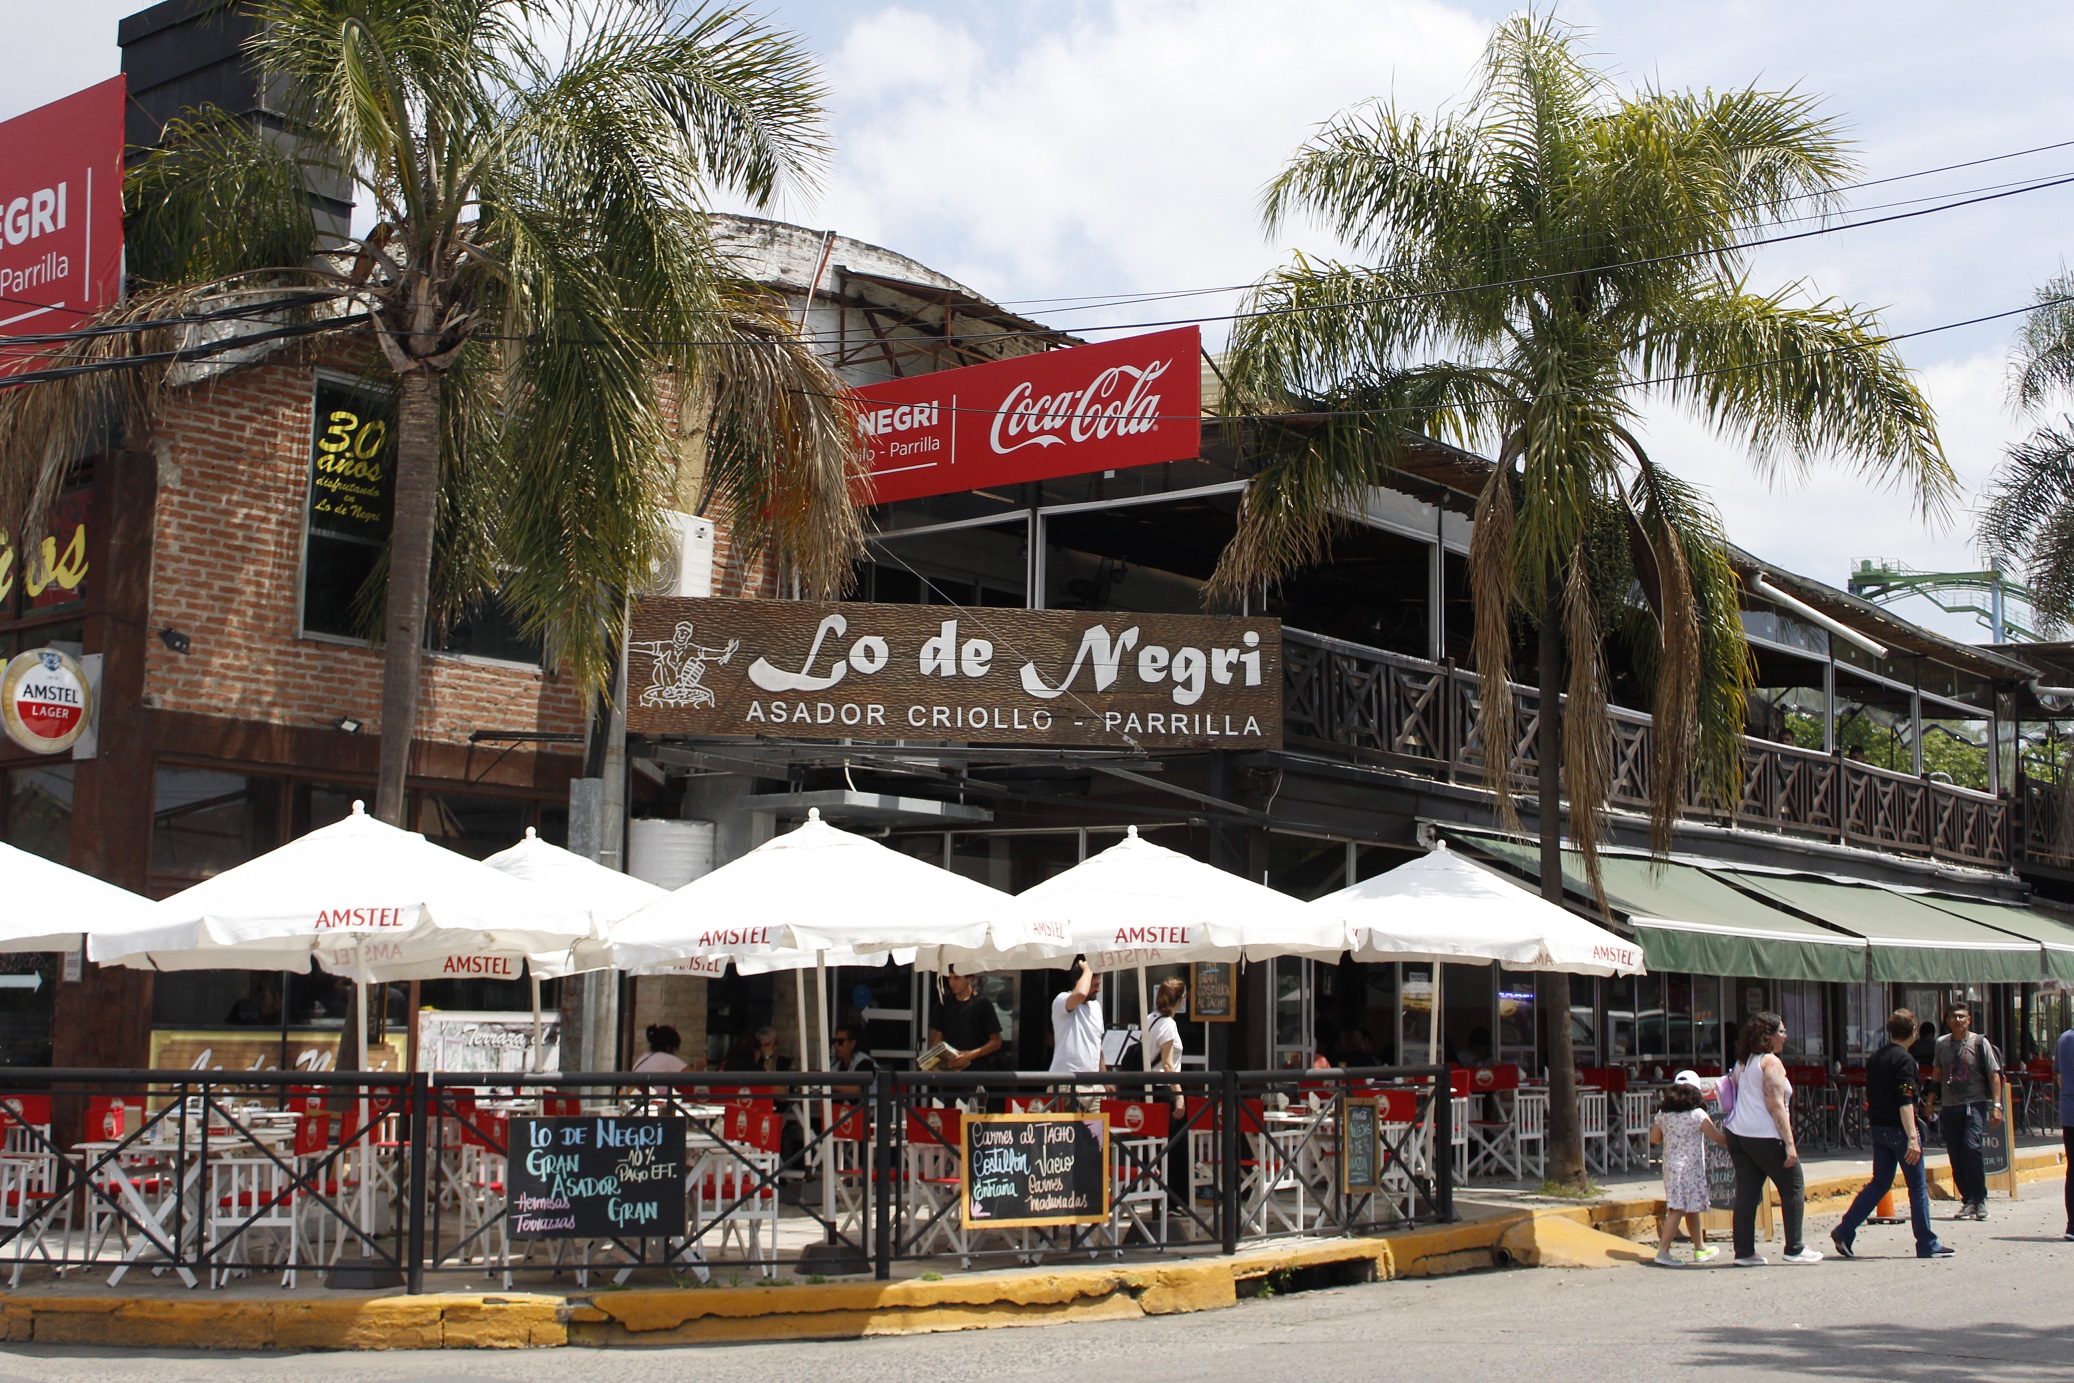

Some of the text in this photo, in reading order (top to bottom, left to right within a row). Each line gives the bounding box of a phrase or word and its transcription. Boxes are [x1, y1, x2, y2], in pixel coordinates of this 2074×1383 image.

[0, 251, 69, 297] Parrilla
[990, 357, 1173, 455] Coca-Cola
[857, 400, 939, 438] NEGRI
[318, 410, 386, 459] 30
[890, 435, 940, 458] Parrilla
[316, 451, 383, 481] años
[316, 475, 380, 497] disfrutando
[334, 503, 348, 515] de
[350, 504, 380, 522] Negri
[747, 613, 1262, 706] Lo de Negri
[23, 683, 79, 704] AMSTEL
[32, 705, 70, 719] LAGER
[745, 701, 886, 726] ASADOR
[907, 705, 1052, 730] CRIOLLO
[1105, 711, 1261, 737] PARRILLA
[315, 907, 404, 929] AMSTEL
[698, 926, 771, 947] AMSTEL
[1114, 926, 1190, 944] AMSTEL
[443, 956, 512, 975] AMSTEL
[1593, 944, 1635, 966] AMSTEL
[463, 1023, 525, 1048] Terraza
[559, 1127, 588, 1146] DE
[972, 1122, 1014, 1148] Carnes
[1020, 1123, 1035, 1145] al
